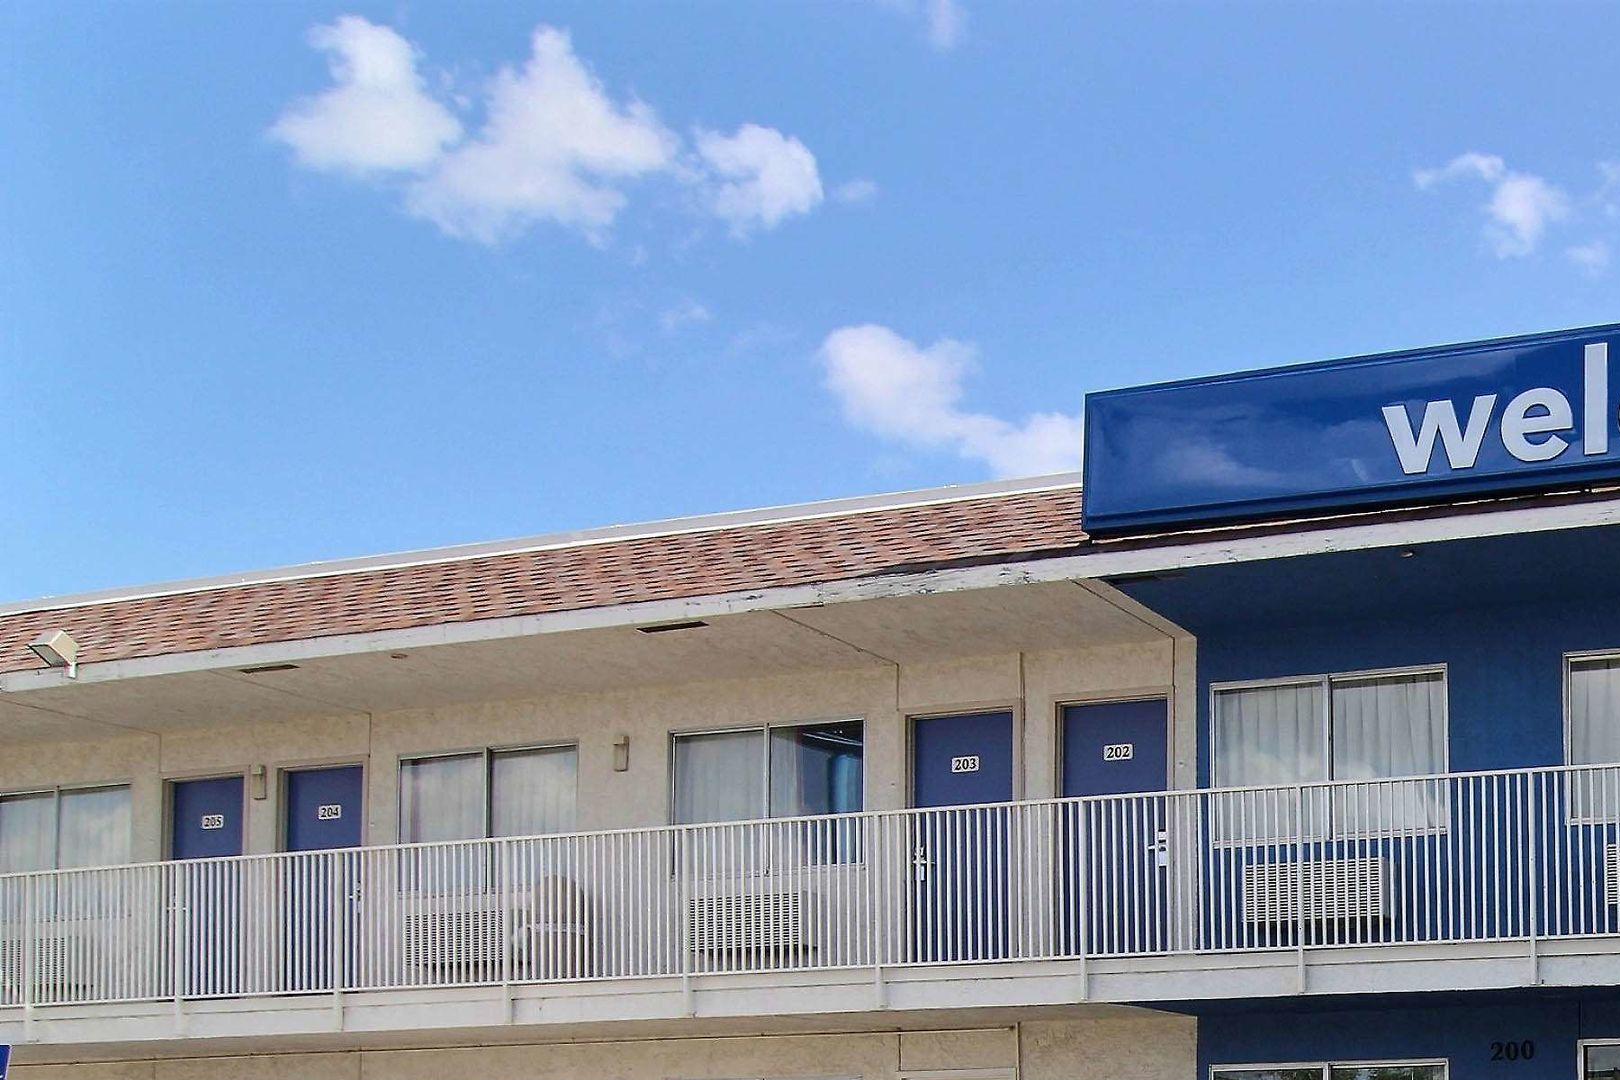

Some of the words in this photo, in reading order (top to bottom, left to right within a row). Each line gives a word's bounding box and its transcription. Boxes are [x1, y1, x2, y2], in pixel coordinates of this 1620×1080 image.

[1106, 746, 1130, 759] 202
[954, 758, 977, 771] 203
[320, 807, 339, 818] 204
[204, 816, 222, 827] 205
[1490, 1040, 1535, 1061] 200
